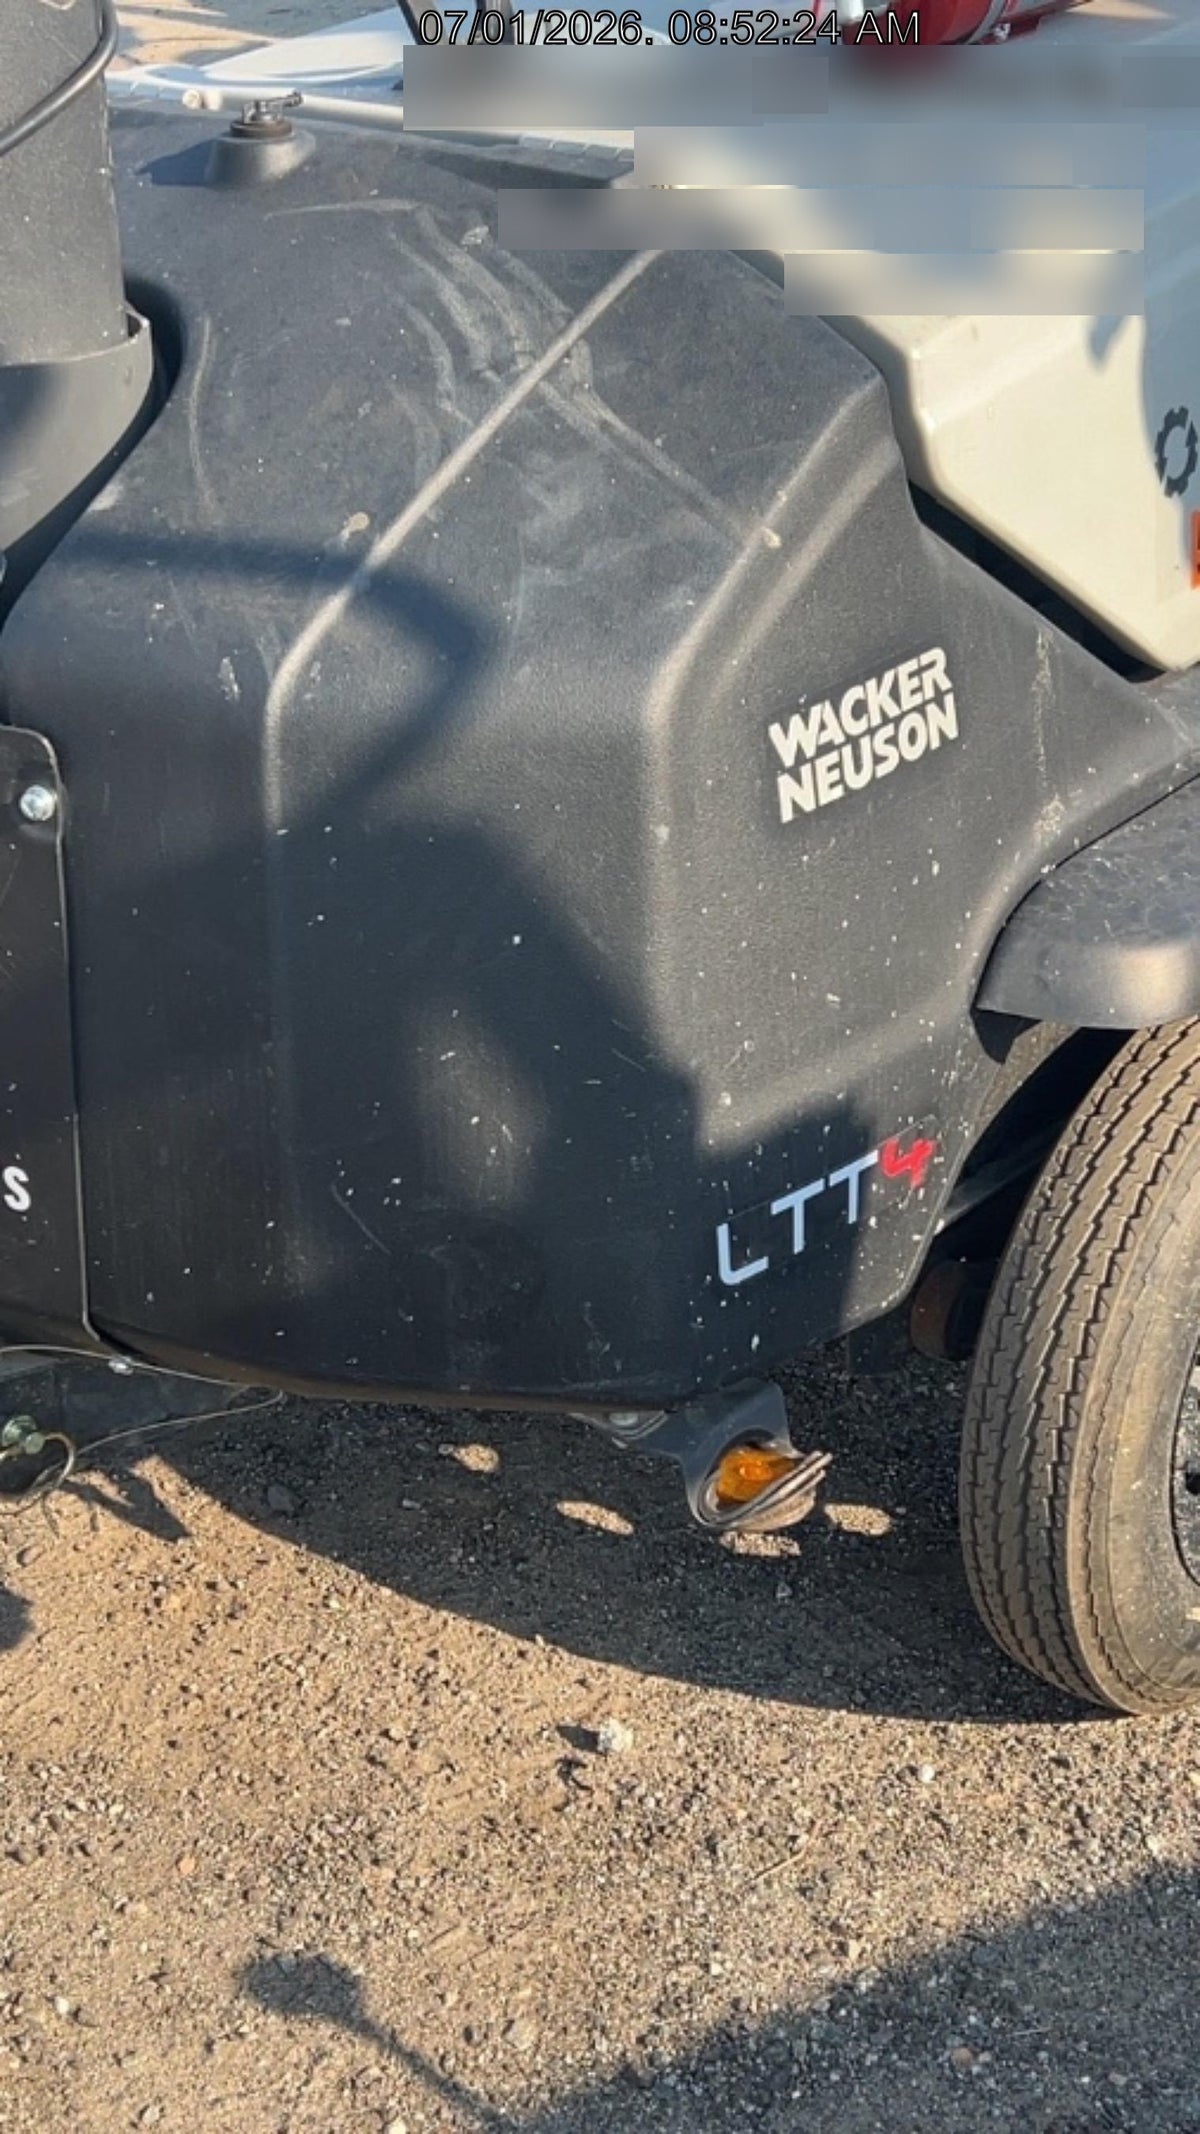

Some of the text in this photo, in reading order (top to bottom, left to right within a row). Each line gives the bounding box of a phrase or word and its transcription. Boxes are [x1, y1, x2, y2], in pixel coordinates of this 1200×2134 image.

[768, 647, 953, 767] WACKER
[777, 692, 959, 823] NEUSON
[716, 1137, 936, 1286] LTT4
